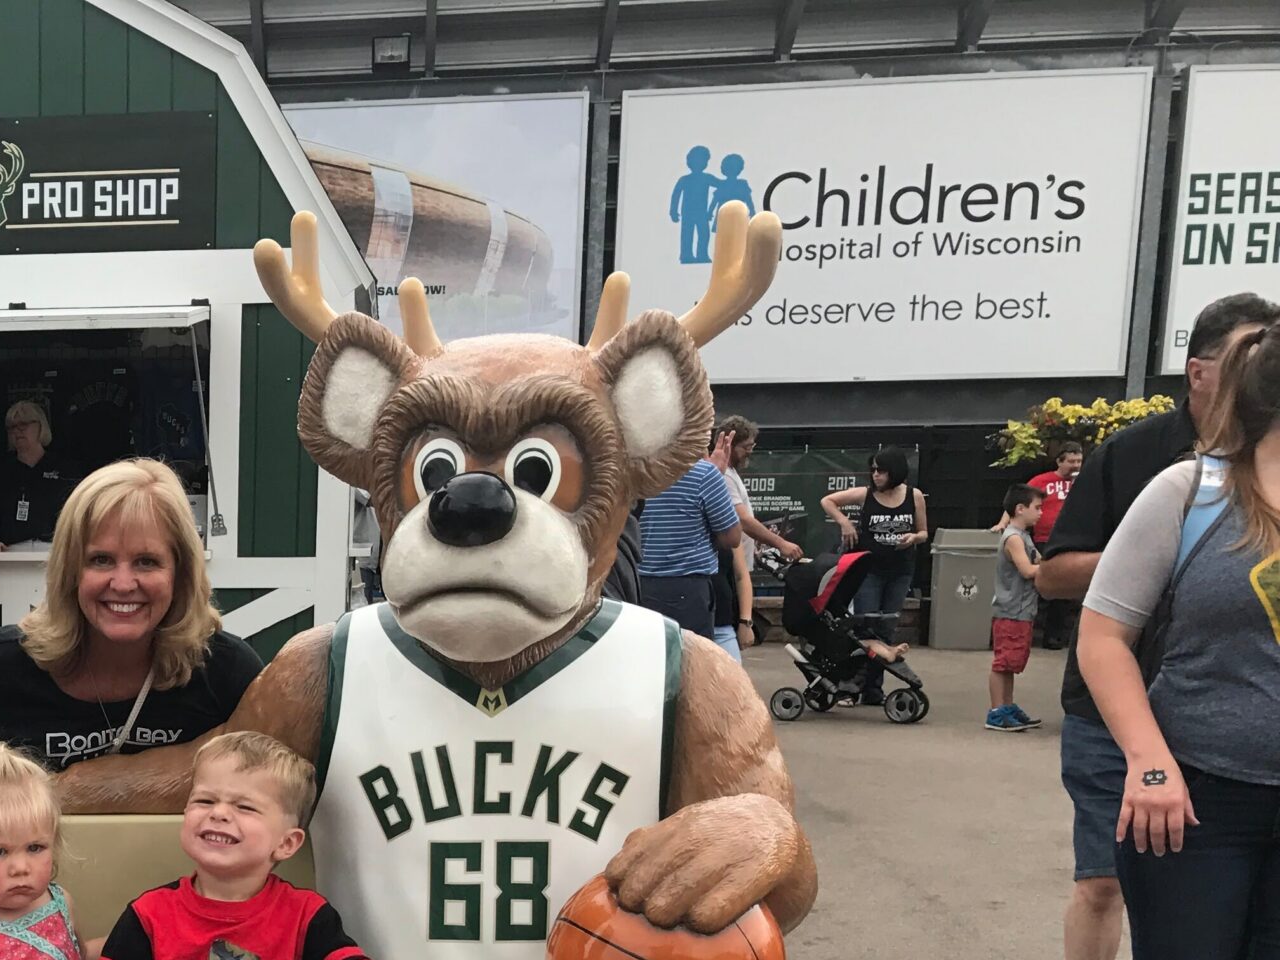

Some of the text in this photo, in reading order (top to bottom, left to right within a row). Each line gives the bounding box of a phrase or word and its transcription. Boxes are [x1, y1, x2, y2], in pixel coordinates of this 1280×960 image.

[22, 180, 83, 219] PRO
[94, 177, 179, 217] SHOP
[777, 229, 1082, 270] ospital of Wisconsin
[1182, 222, 1235, 265] ON
[764, 298, 896, 327] deserve
[908, 294, 963, 322] the
[974, 291, 1052, 320] best.
[873, 533, 904, 541] SALOO
[135, 727, 183, 744] BAY
[358, 740, 631, 843] BUCKS
[426, 839, 551, 944] 68
